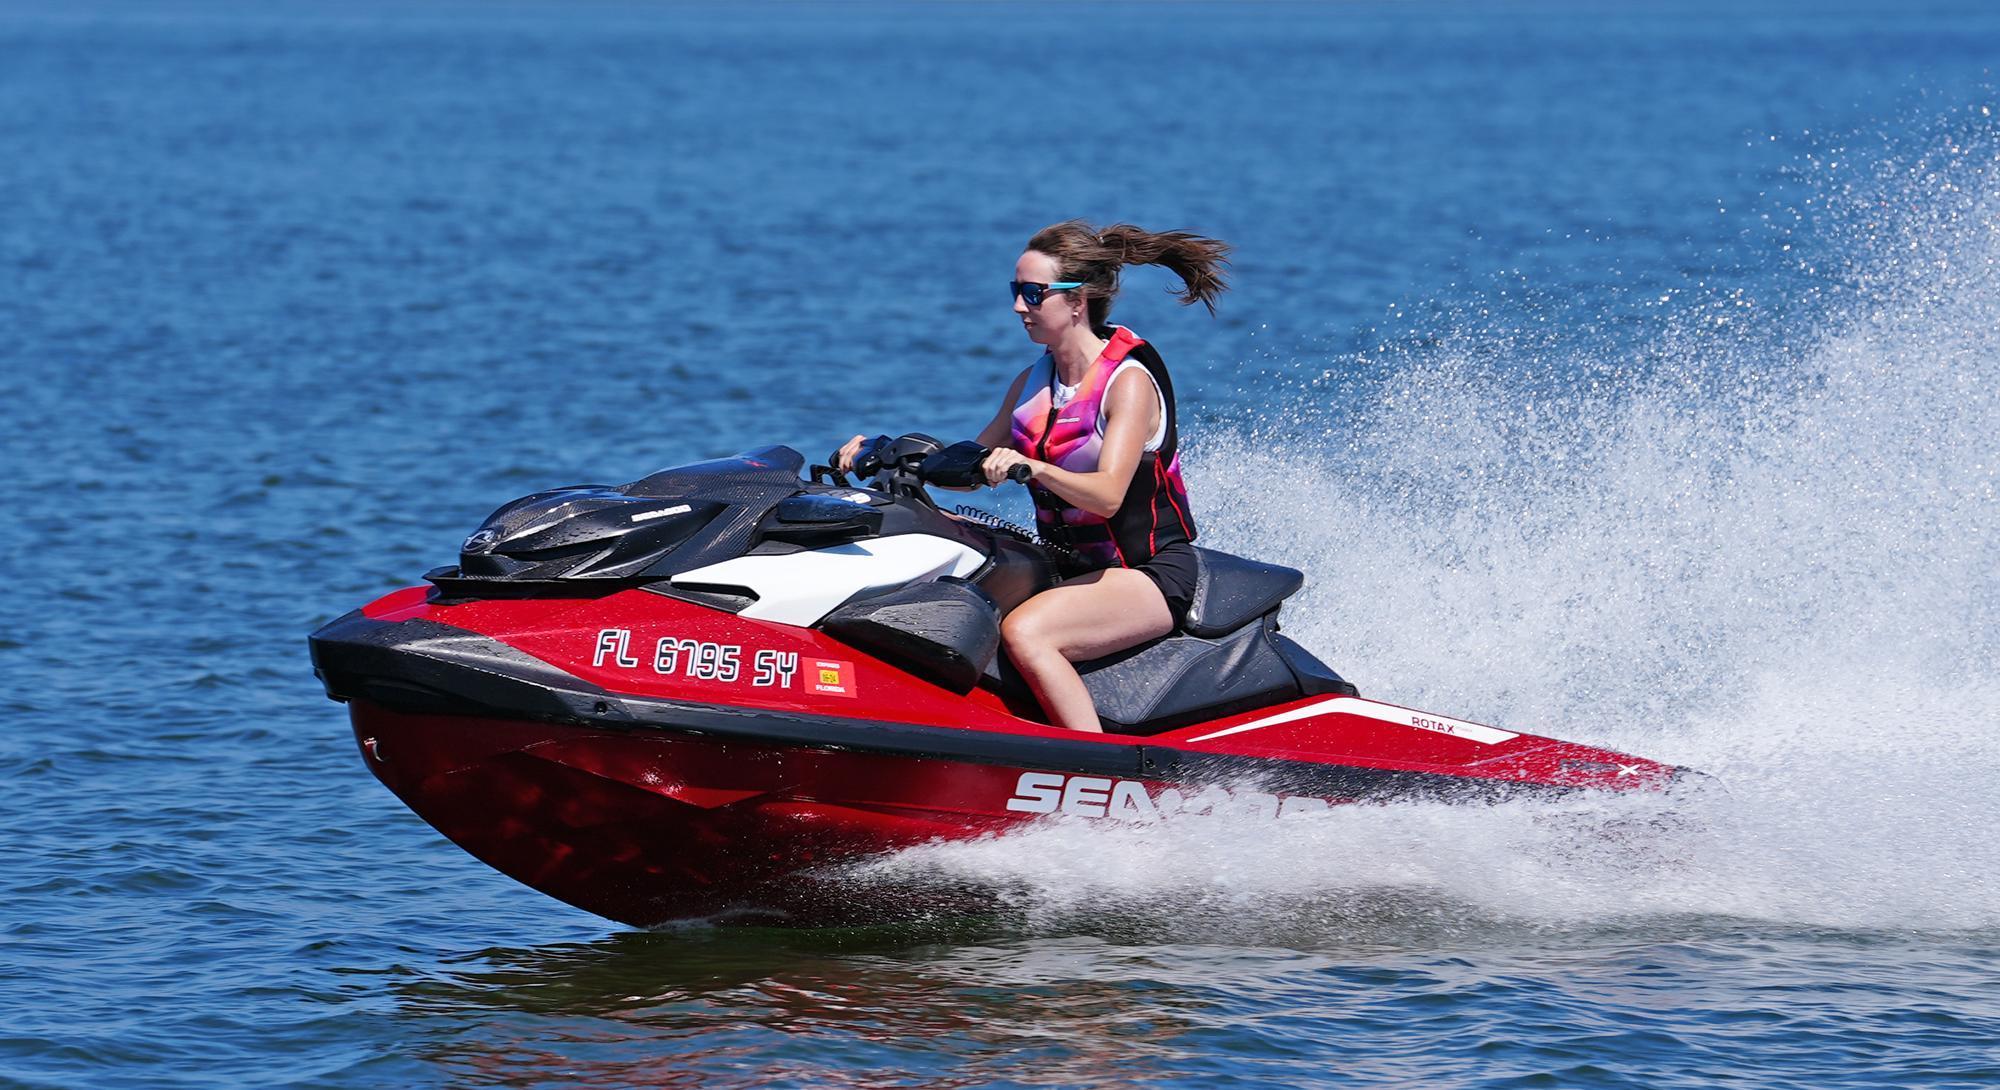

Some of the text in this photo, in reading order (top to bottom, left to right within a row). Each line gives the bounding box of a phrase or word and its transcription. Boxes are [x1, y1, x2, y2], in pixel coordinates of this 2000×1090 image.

[592, 629, 798, 689] FL 6795 SY
[1411, 716, 1455, 734] ROTAX
